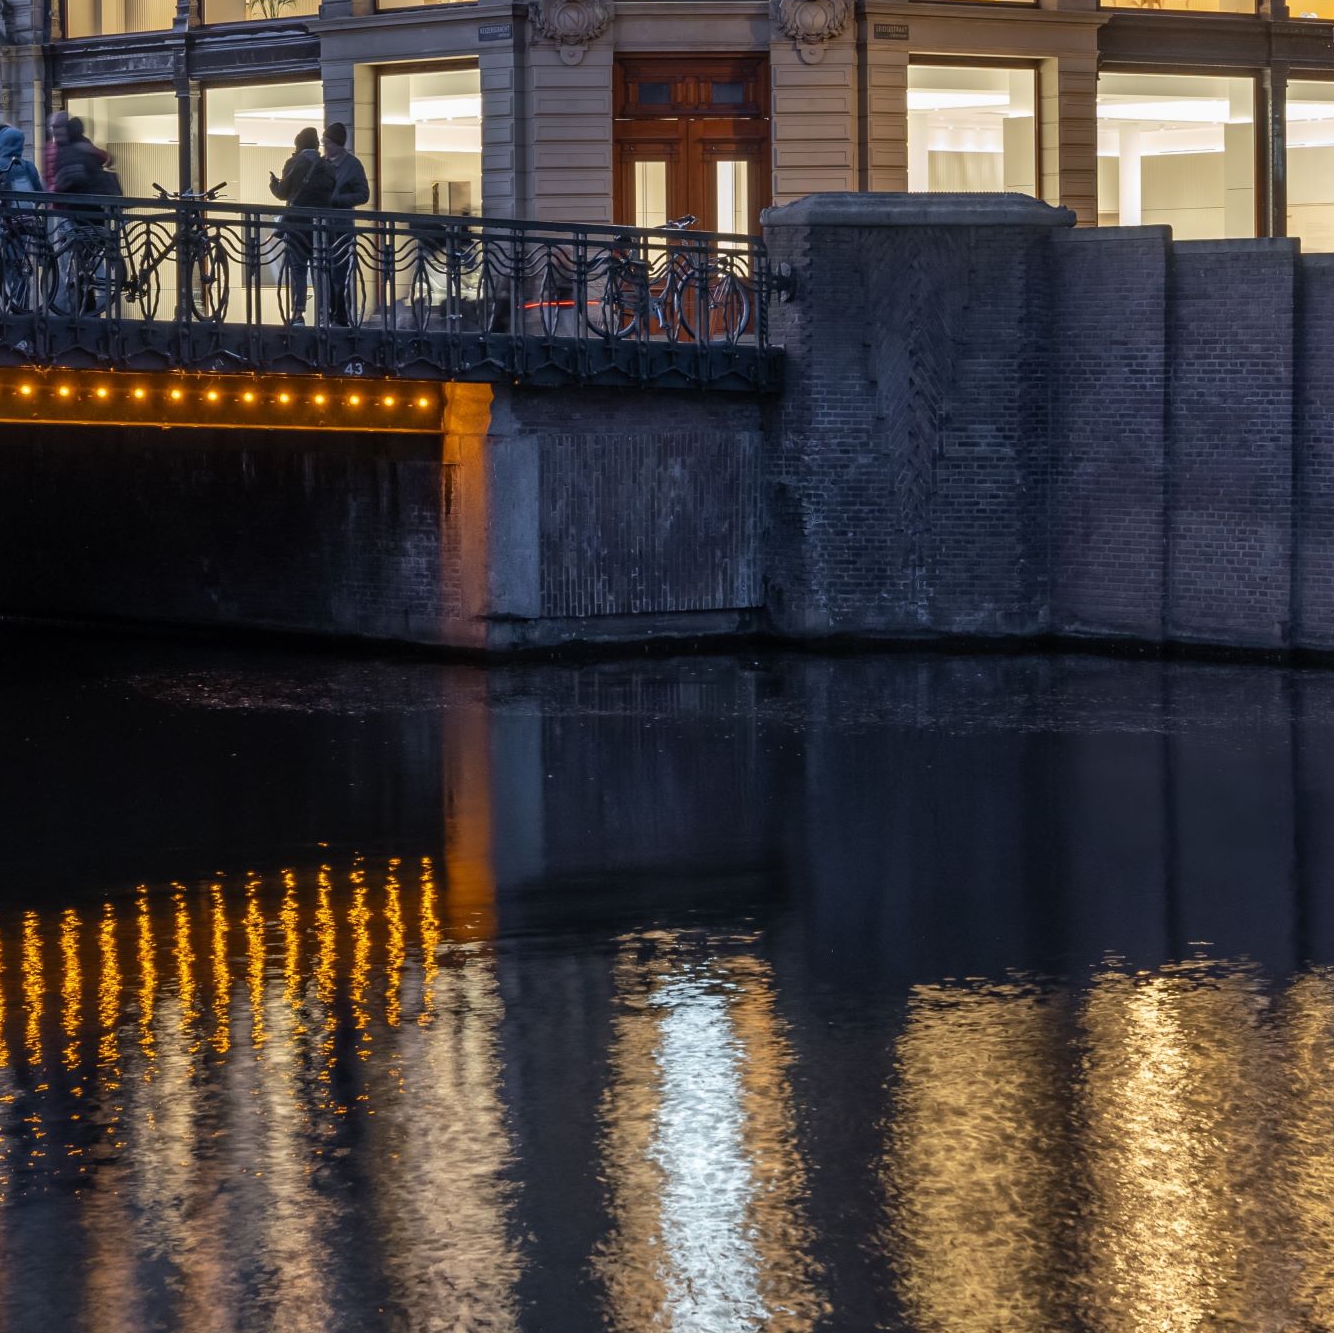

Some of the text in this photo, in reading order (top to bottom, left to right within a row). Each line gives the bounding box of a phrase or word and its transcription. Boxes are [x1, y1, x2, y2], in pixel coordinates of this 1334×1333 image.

[565, 11, 583, 28] N
[809, 10, 825, 26] Y
[344, 362, 363, 375] 43
